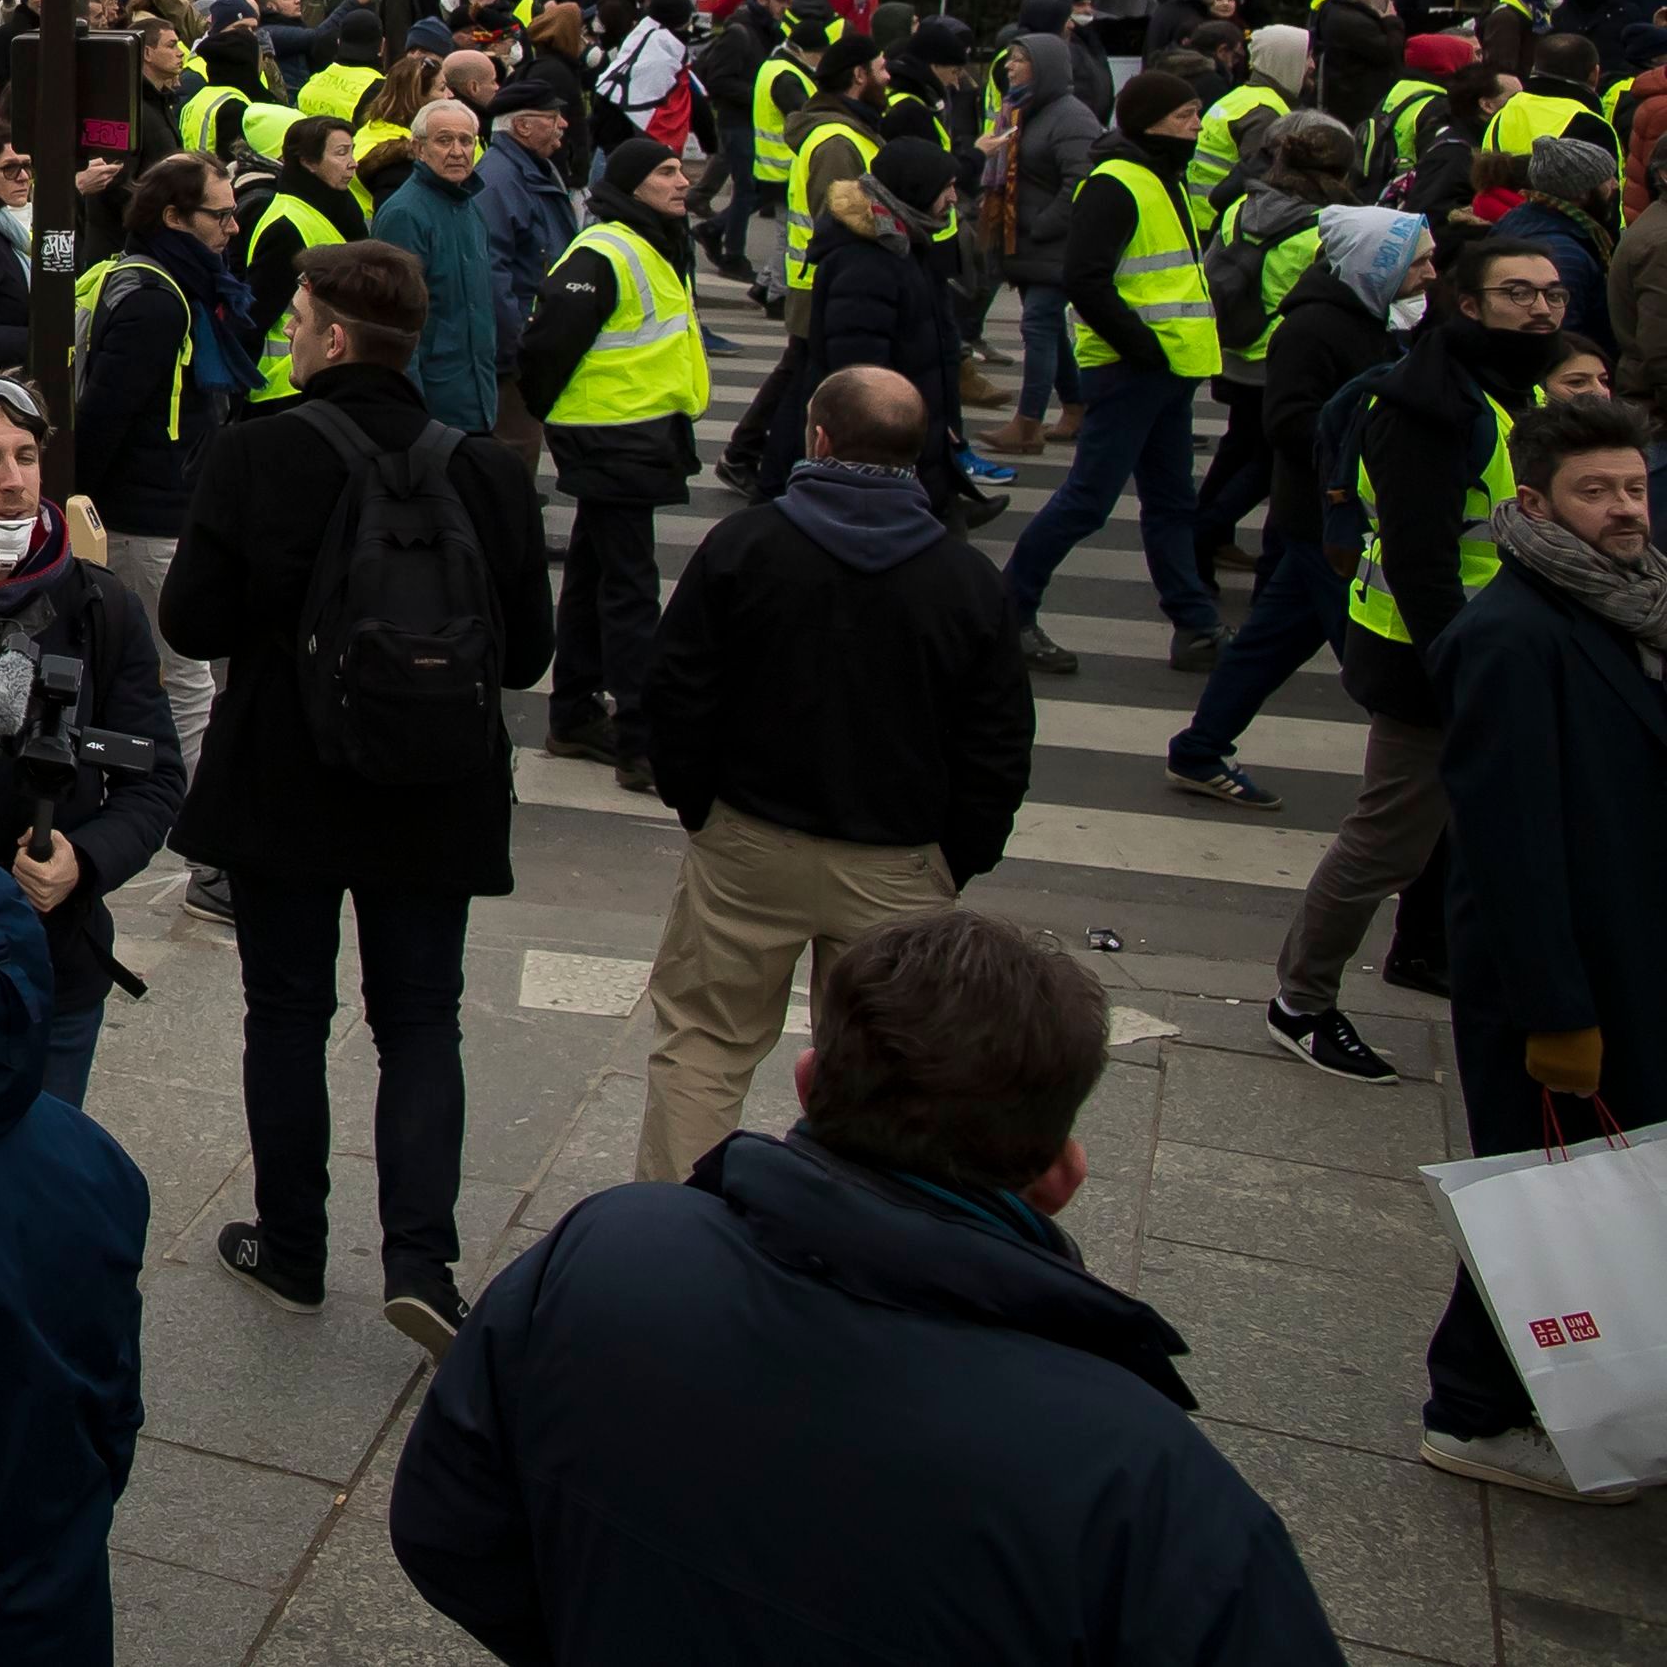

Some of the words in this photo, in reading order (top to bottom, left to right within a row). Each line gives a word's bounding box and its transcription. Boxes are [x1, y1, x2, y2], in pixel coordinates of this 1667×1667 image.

[86, 741, 105, 752] 4K
[1566, 1315, 1589, 1328] UNI
[1572, 1326, 1596, 1340] QLO
